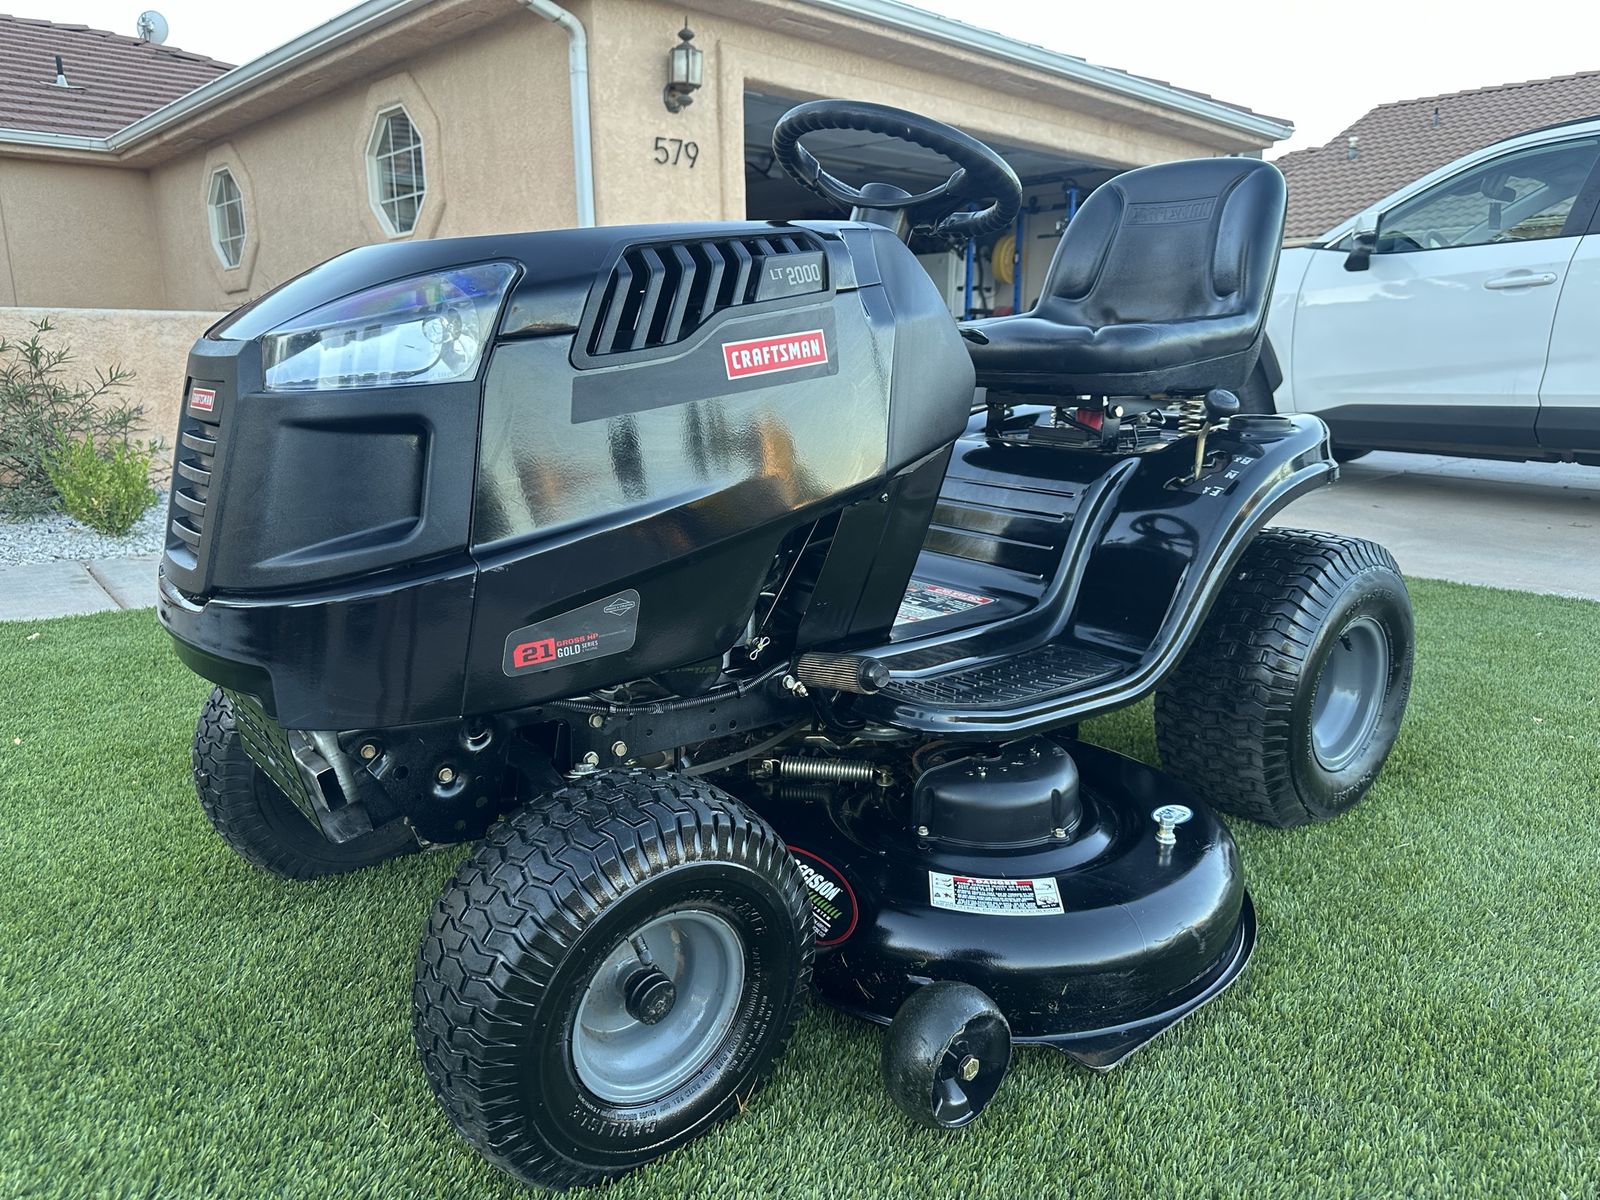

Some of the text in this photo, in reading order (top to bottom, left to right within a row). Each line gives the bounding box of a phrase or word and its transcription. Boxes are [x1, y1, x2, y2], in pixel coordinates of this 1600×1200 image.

[654, 136, 699, 169] 579
[769, 263, 821, 286] LT 2000
[731, 338, 821, 370] CRAFTSMAN
[556, 632, 599, 647] GROSS HP
[582, 640, 599, 649] SERIES
[522, 643, 553, 663] 21
[557, 644, 581, 658] GOLD
